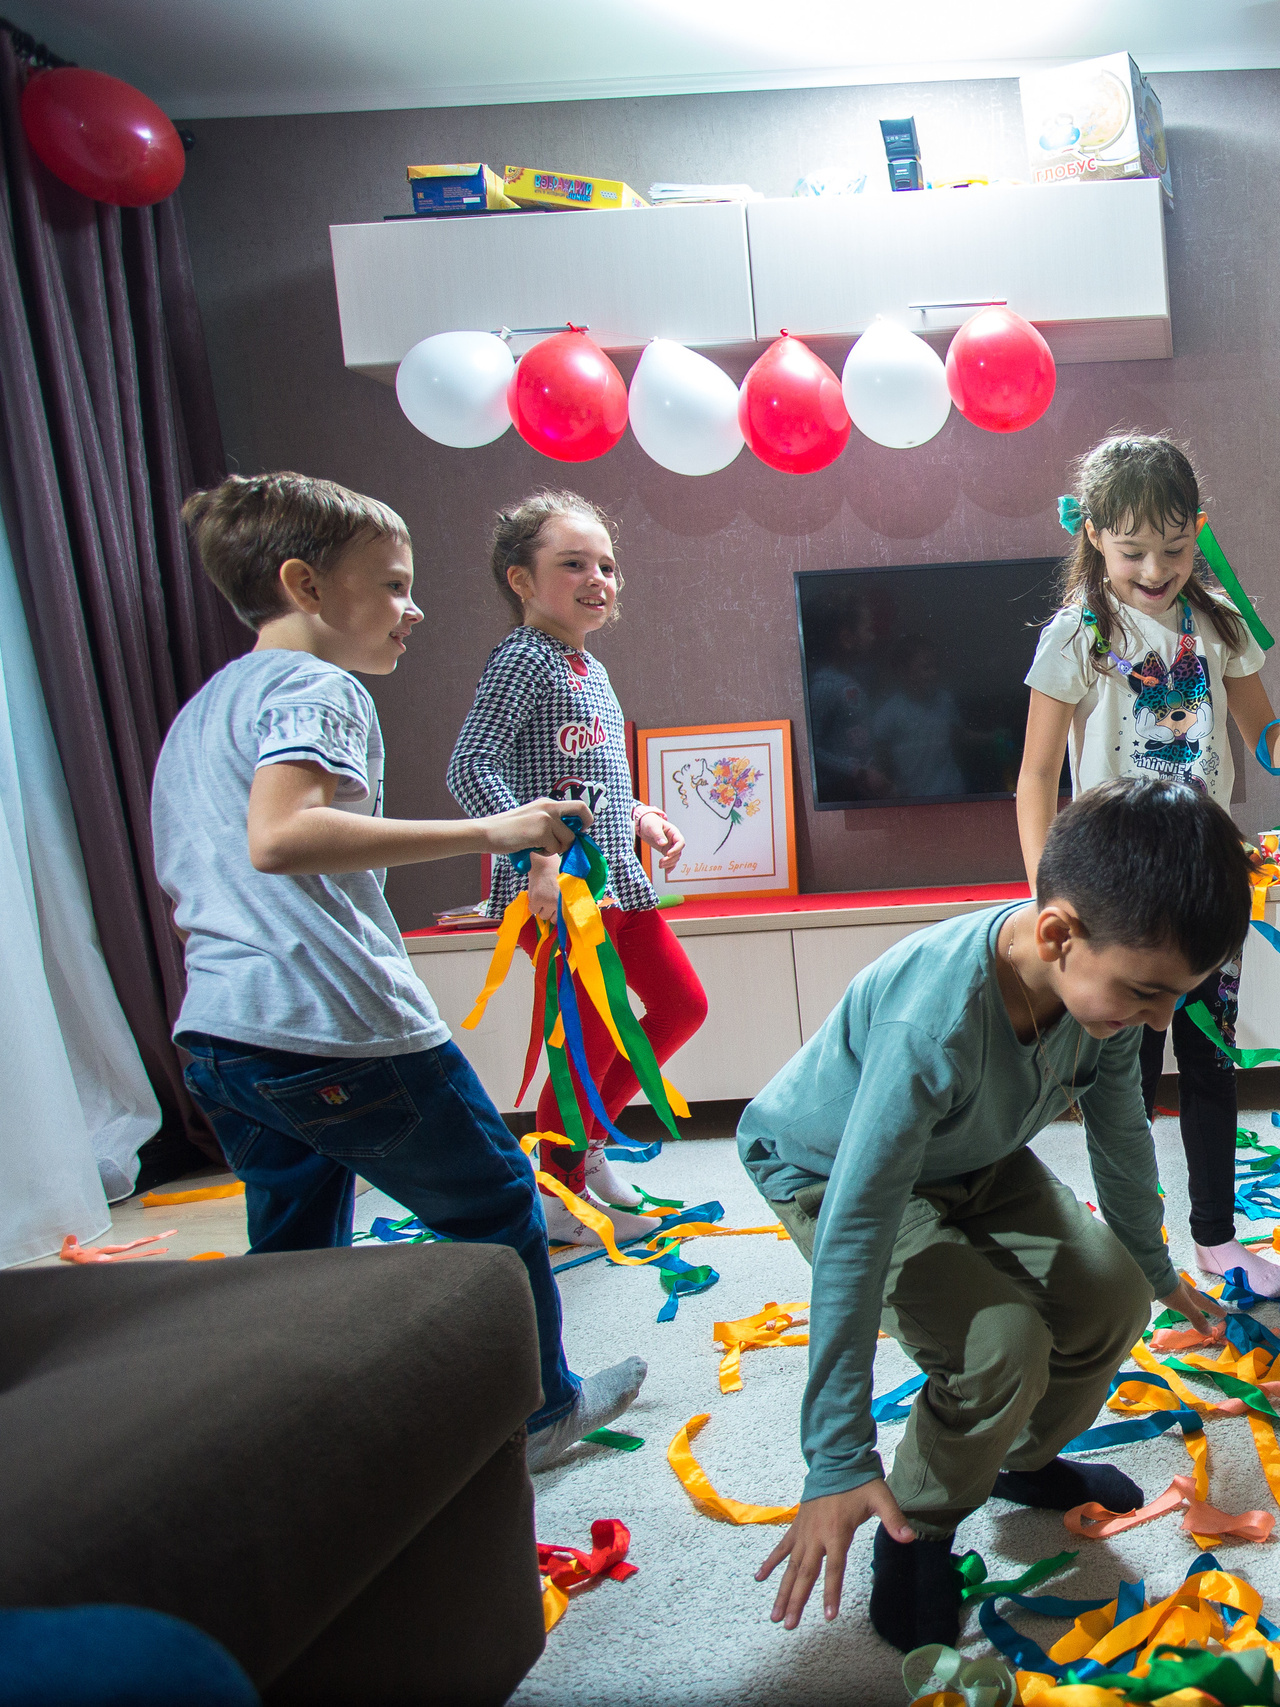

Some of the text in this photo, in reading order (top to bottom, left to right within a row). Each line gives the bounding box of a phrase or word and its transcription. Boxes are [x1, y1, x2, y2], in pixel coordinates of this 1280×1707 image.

[1036, 158, 1097, 183] ГЛОБУС
[560, 716, 606, 756] Girls
[727, 860, 758, 873] Spring
